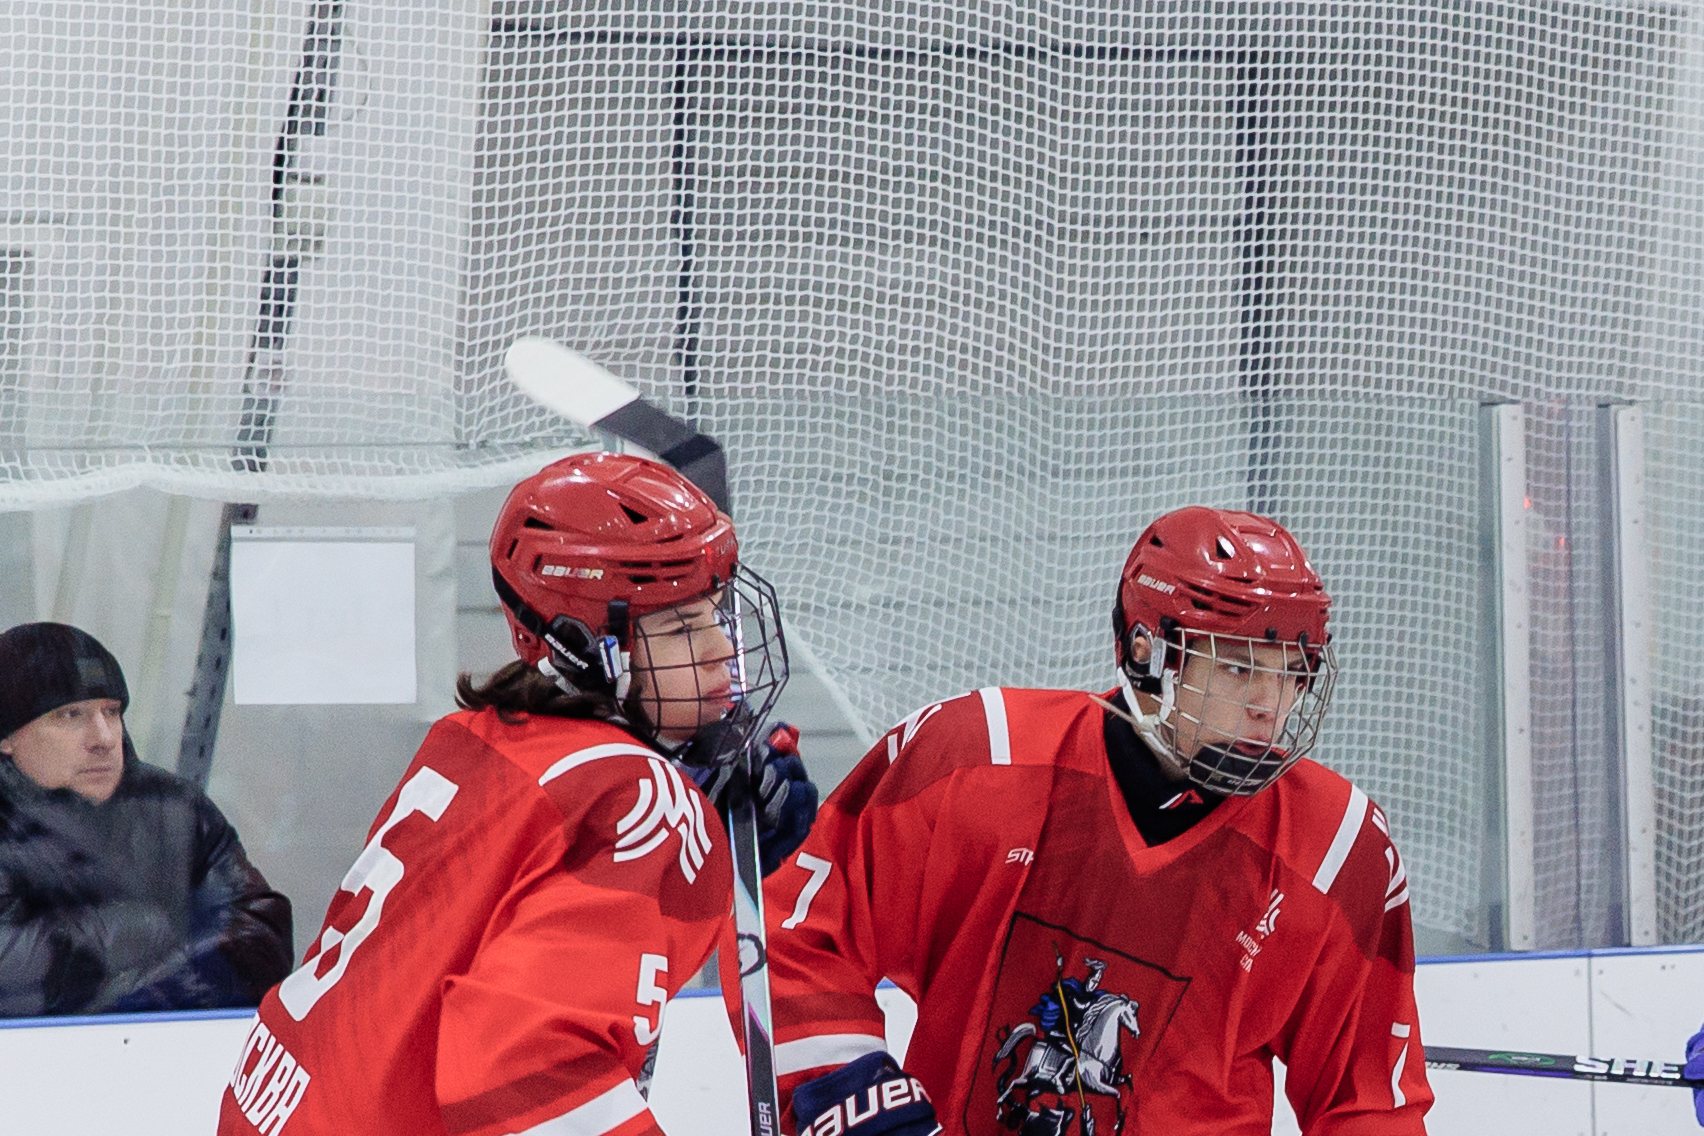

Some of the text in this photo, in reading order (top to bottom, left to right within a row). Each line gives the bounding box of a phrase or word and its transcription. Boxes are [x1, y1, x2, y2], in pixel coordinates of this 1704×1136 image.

[278, 765, 460, 1022] 5
[781, 851, 833, 930] 7
[632, 952, 669, 1045] 5
